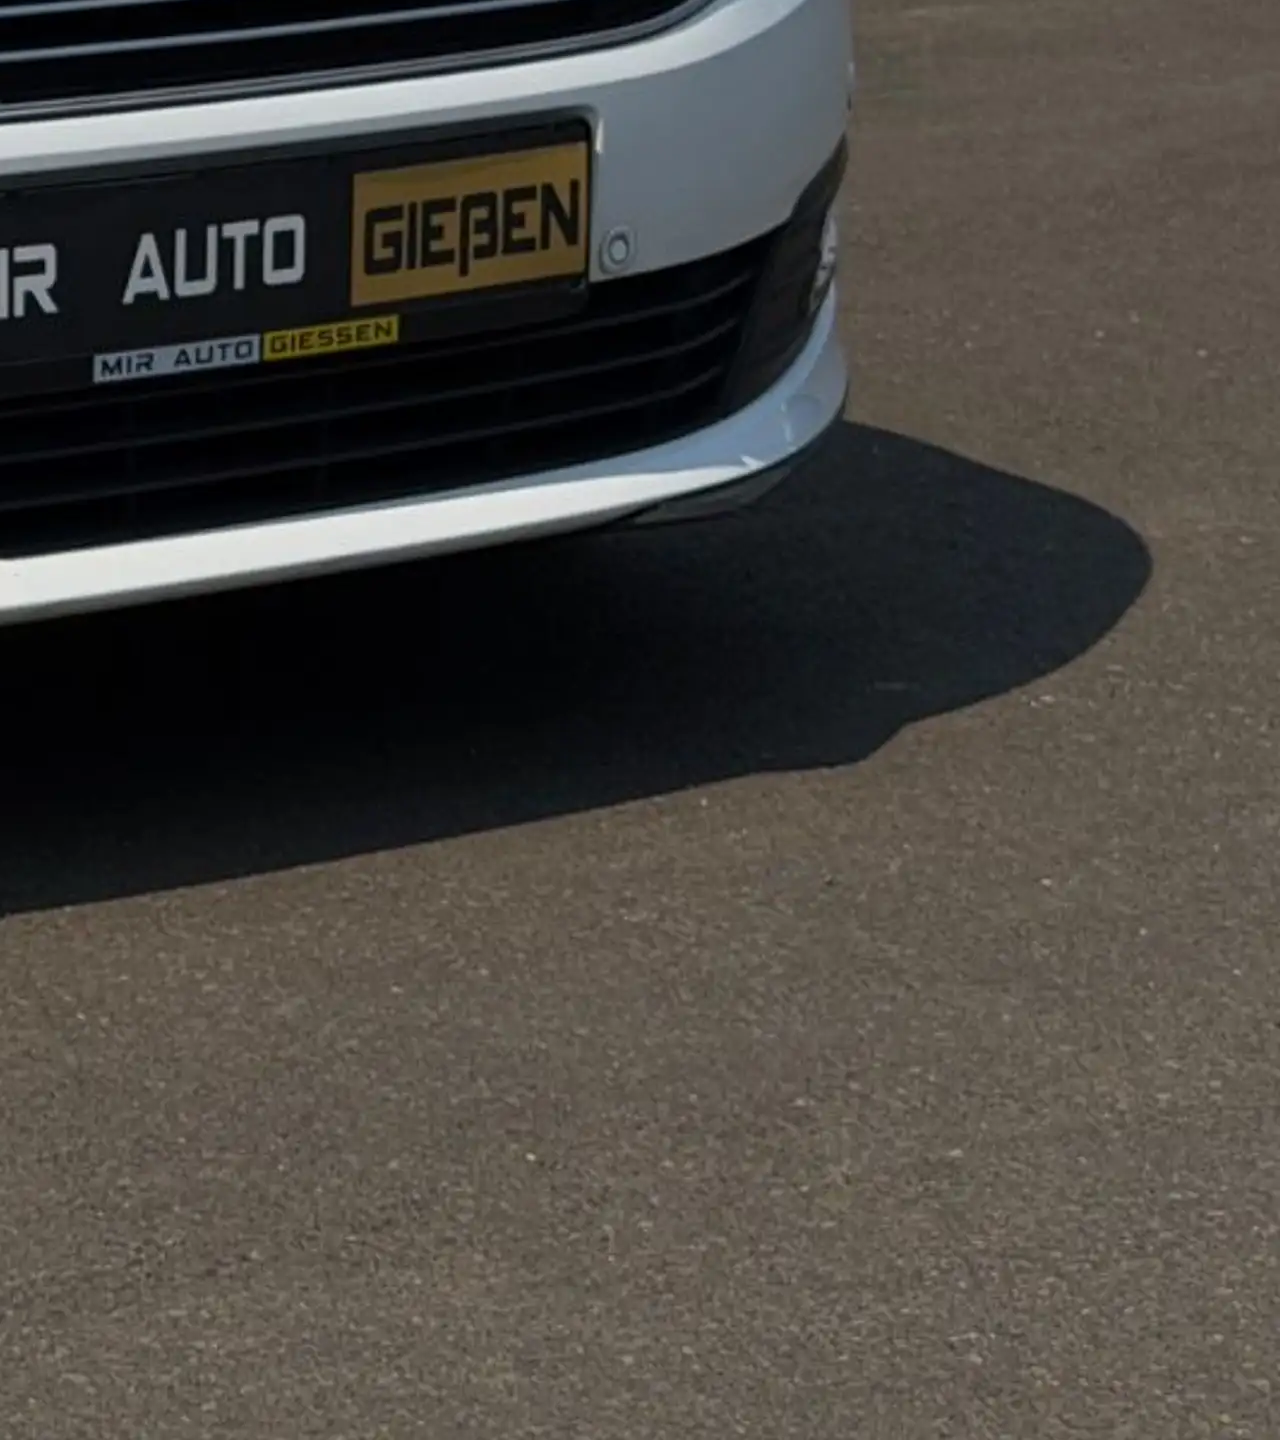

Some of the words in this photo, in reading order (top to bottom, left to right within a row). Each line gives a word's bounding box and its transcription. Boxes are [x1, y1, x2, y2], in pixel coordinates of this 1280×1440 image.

[122, 214, 305, 305] AUTO
[100, 352, 154, 378] MIR
[174, 340, 254, 366] AUTO
[269, 320, 392, 354] GIESSEN
